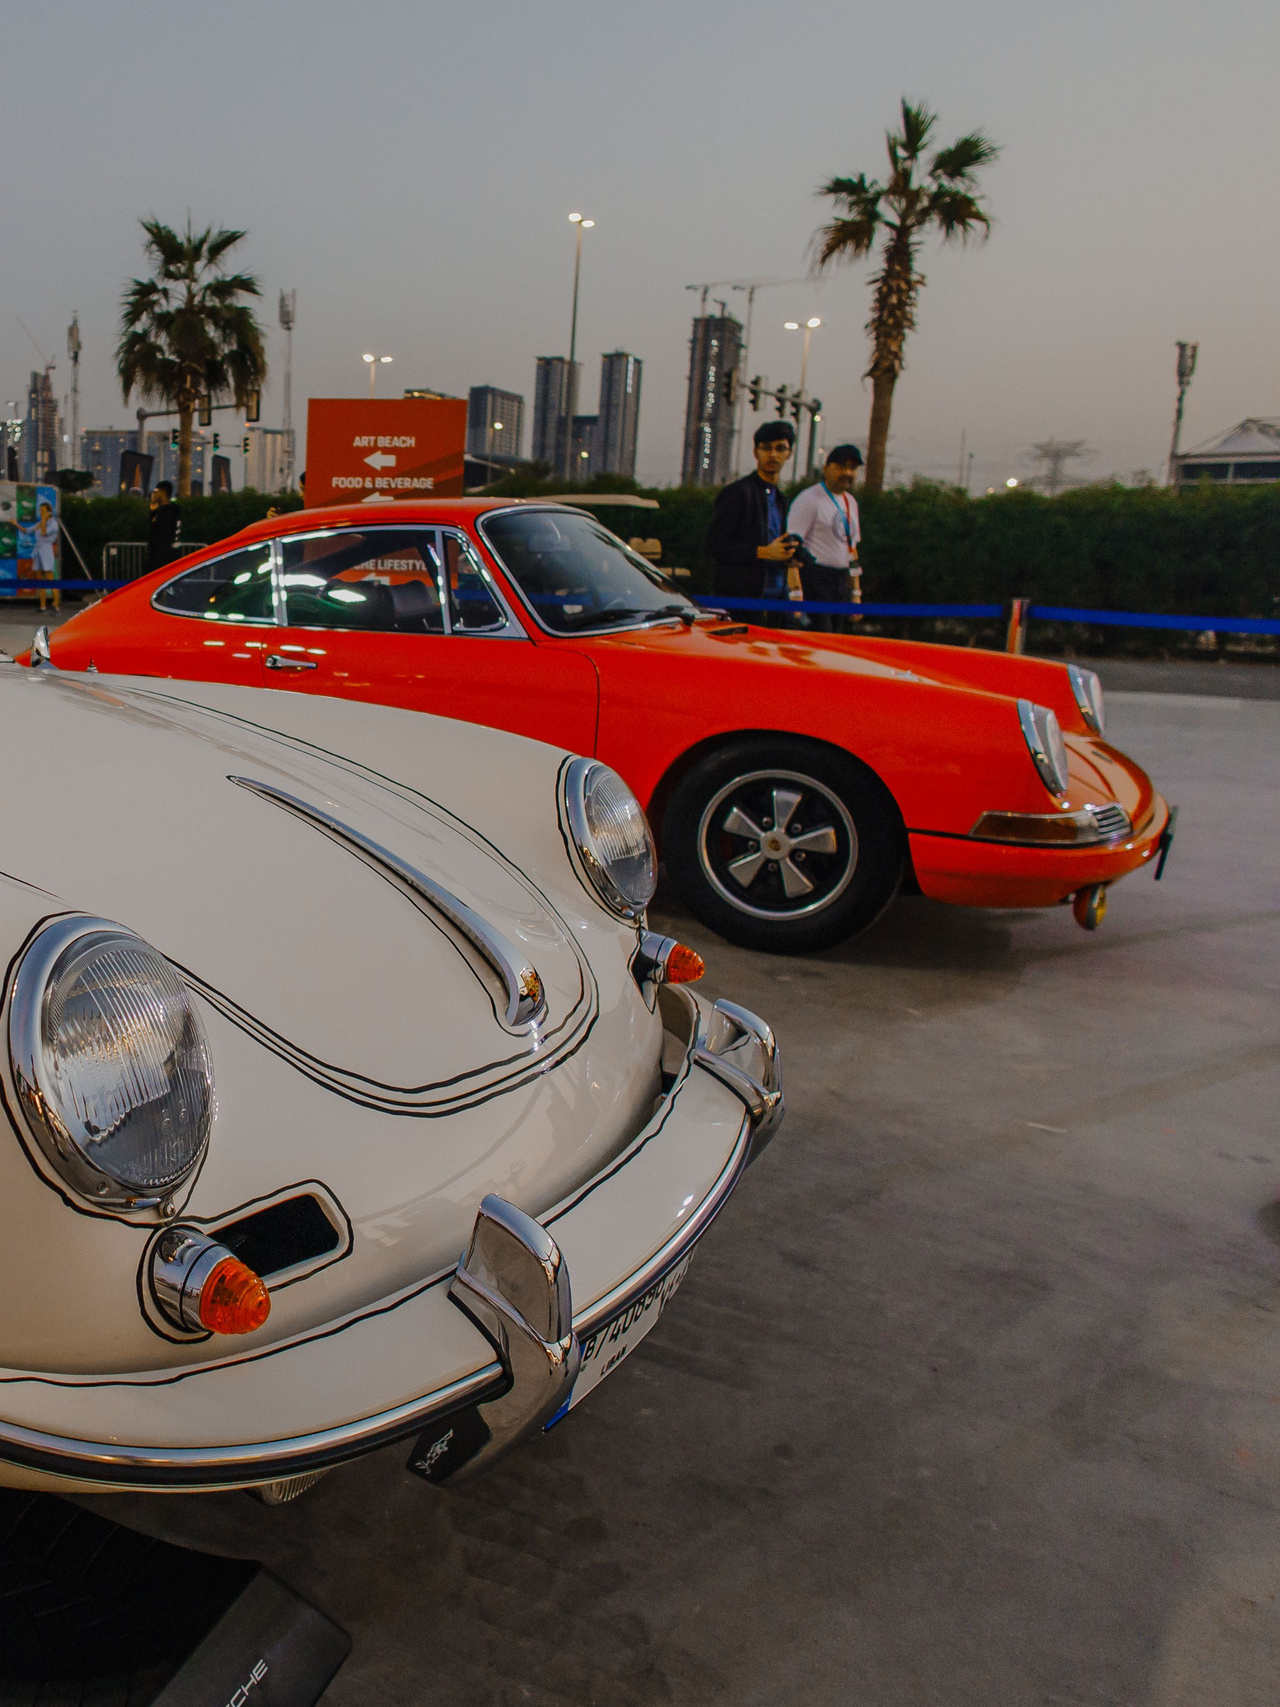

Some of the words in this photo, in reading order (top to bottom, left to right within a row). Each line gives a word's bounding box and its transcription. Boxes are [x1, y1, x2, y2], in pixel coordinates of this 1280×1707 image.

[353, 436, 376, 448] ART
[377, 436, 416, 448] BEACH
[331, 477, 363, 488] FOOD
[364, 477, 373, 488] &
[375, 477, 434, 489] BEVERAGE
[225, 1658, 269, 1707] CHE
